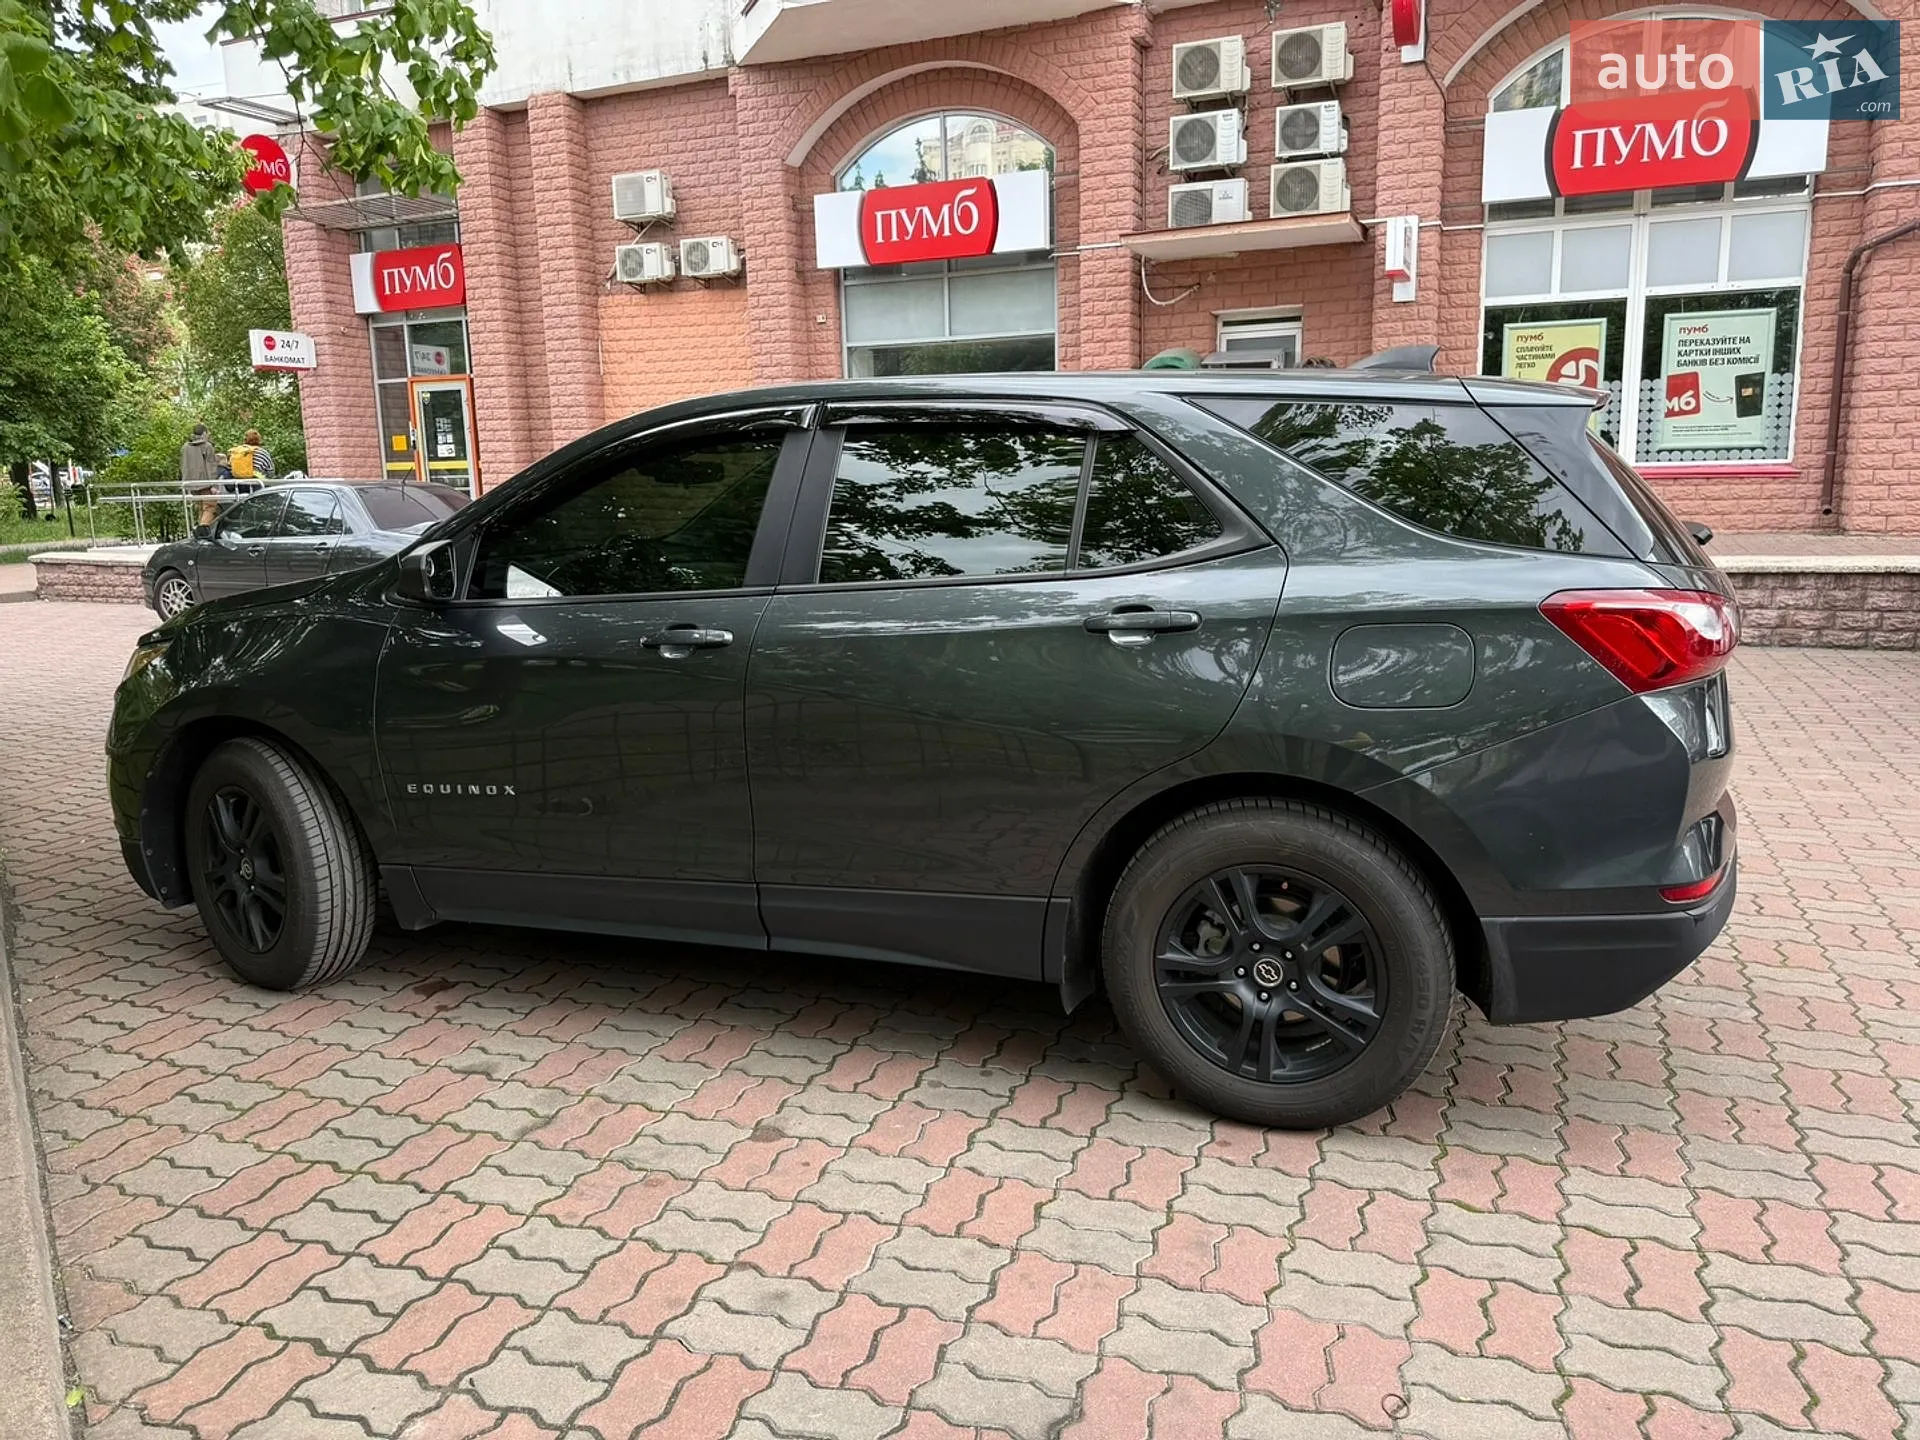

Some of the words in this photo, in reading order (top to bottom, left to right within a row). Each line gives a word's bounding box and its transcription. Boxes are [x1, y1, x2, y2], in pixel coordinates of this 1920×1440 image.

[280, 339, 299, 350] 24/7
[1678, 336, 1738, 347] ПЕРЕКАЗУЙТЕ
[1738, 335, 1751, 344] НА
[1515, 353, 1556, 361] ЧАСТИНАМИ
[1677, 348, 1711, 357] КАРТКИ
[1712, 347, 1742, 356] ІНШИХ
[264, 355, 305, 364] БАНКОМАТ
[1677, 358, 1708, 367] БАНКІВ
[1709, 357, 1726, 366] БЕЗ
[1726, 353, 1760, 365] КОМІСІЇ
[1515, 361, 1536, 369] ЛЕГКО
[406, 783, 516, 796] EQUINOX
